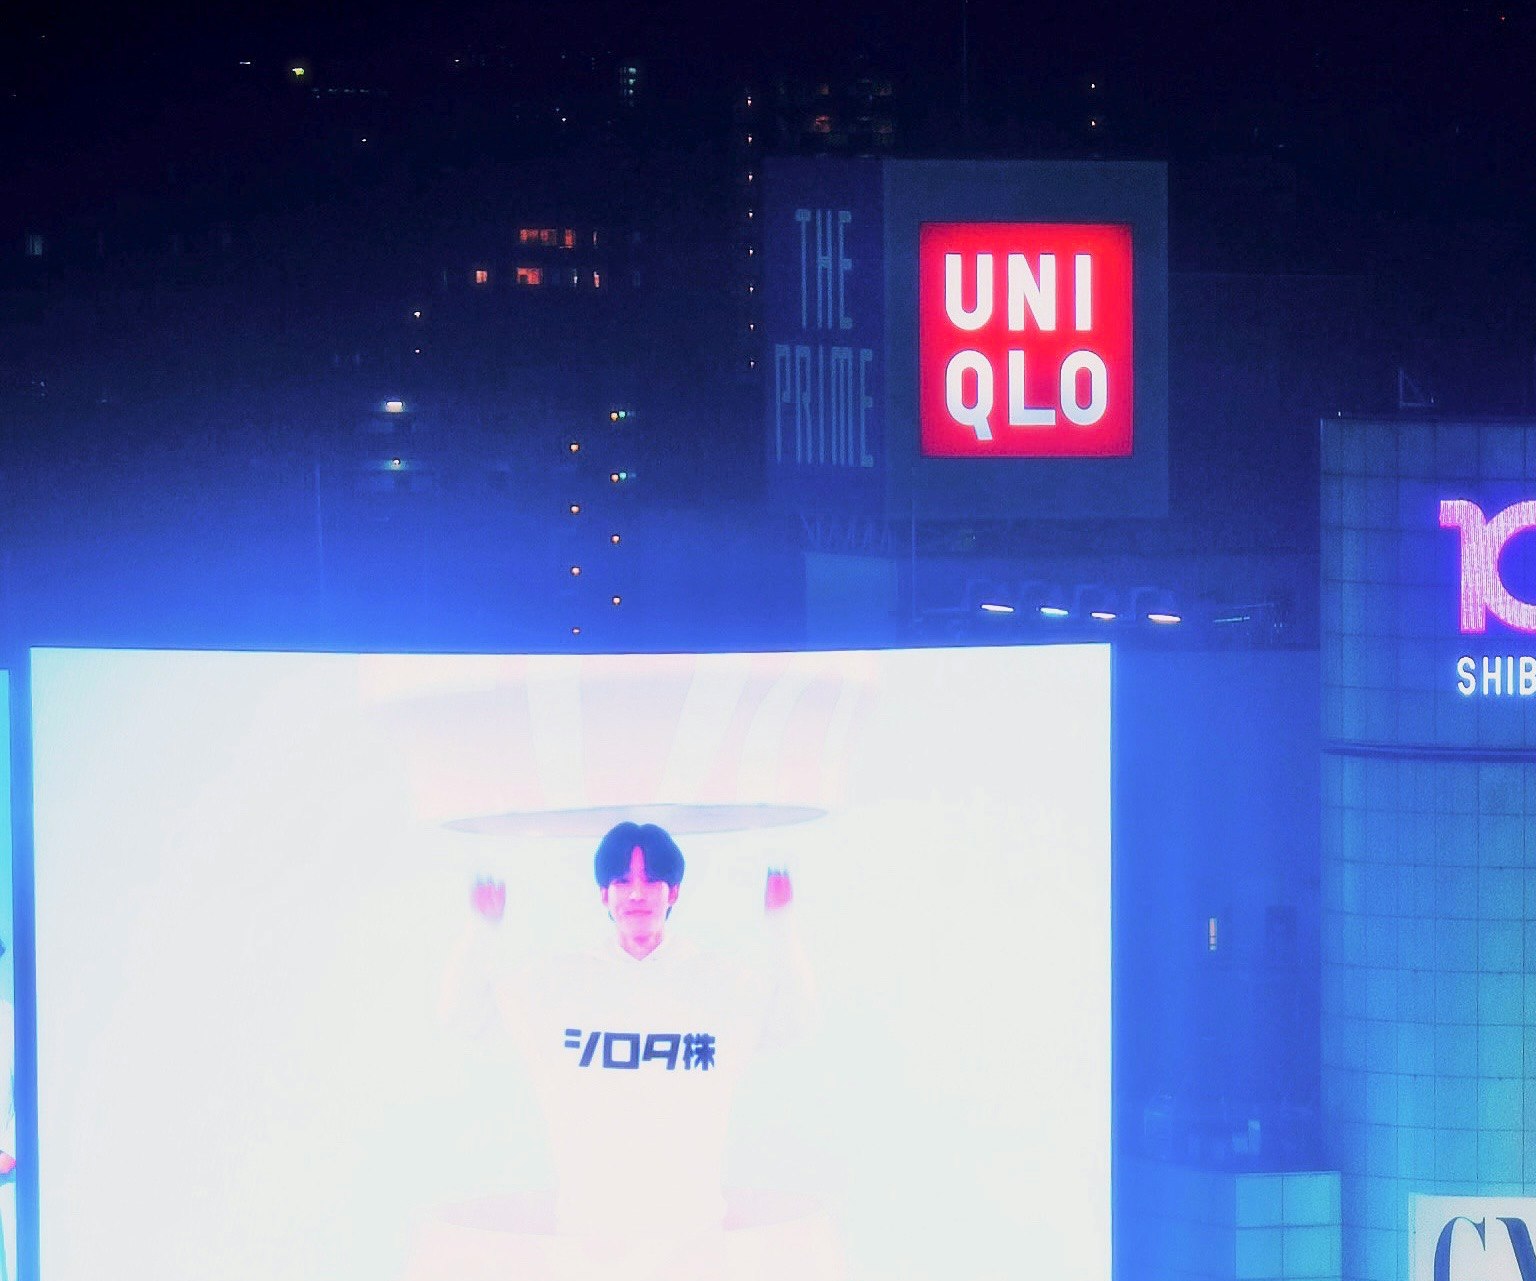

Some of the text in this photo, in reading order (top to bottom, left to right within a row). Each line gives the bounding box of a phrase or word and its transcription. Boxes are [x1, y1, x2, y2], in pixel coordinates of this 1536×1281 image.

[795, 208, 853, 330] THE
[944, 253, 1092, 332] UNI
[775, 344, 873, 467] PRIME
[944, 350, 1108, 441] QLO
[564, 1028, 716, 1071] シロタ株
